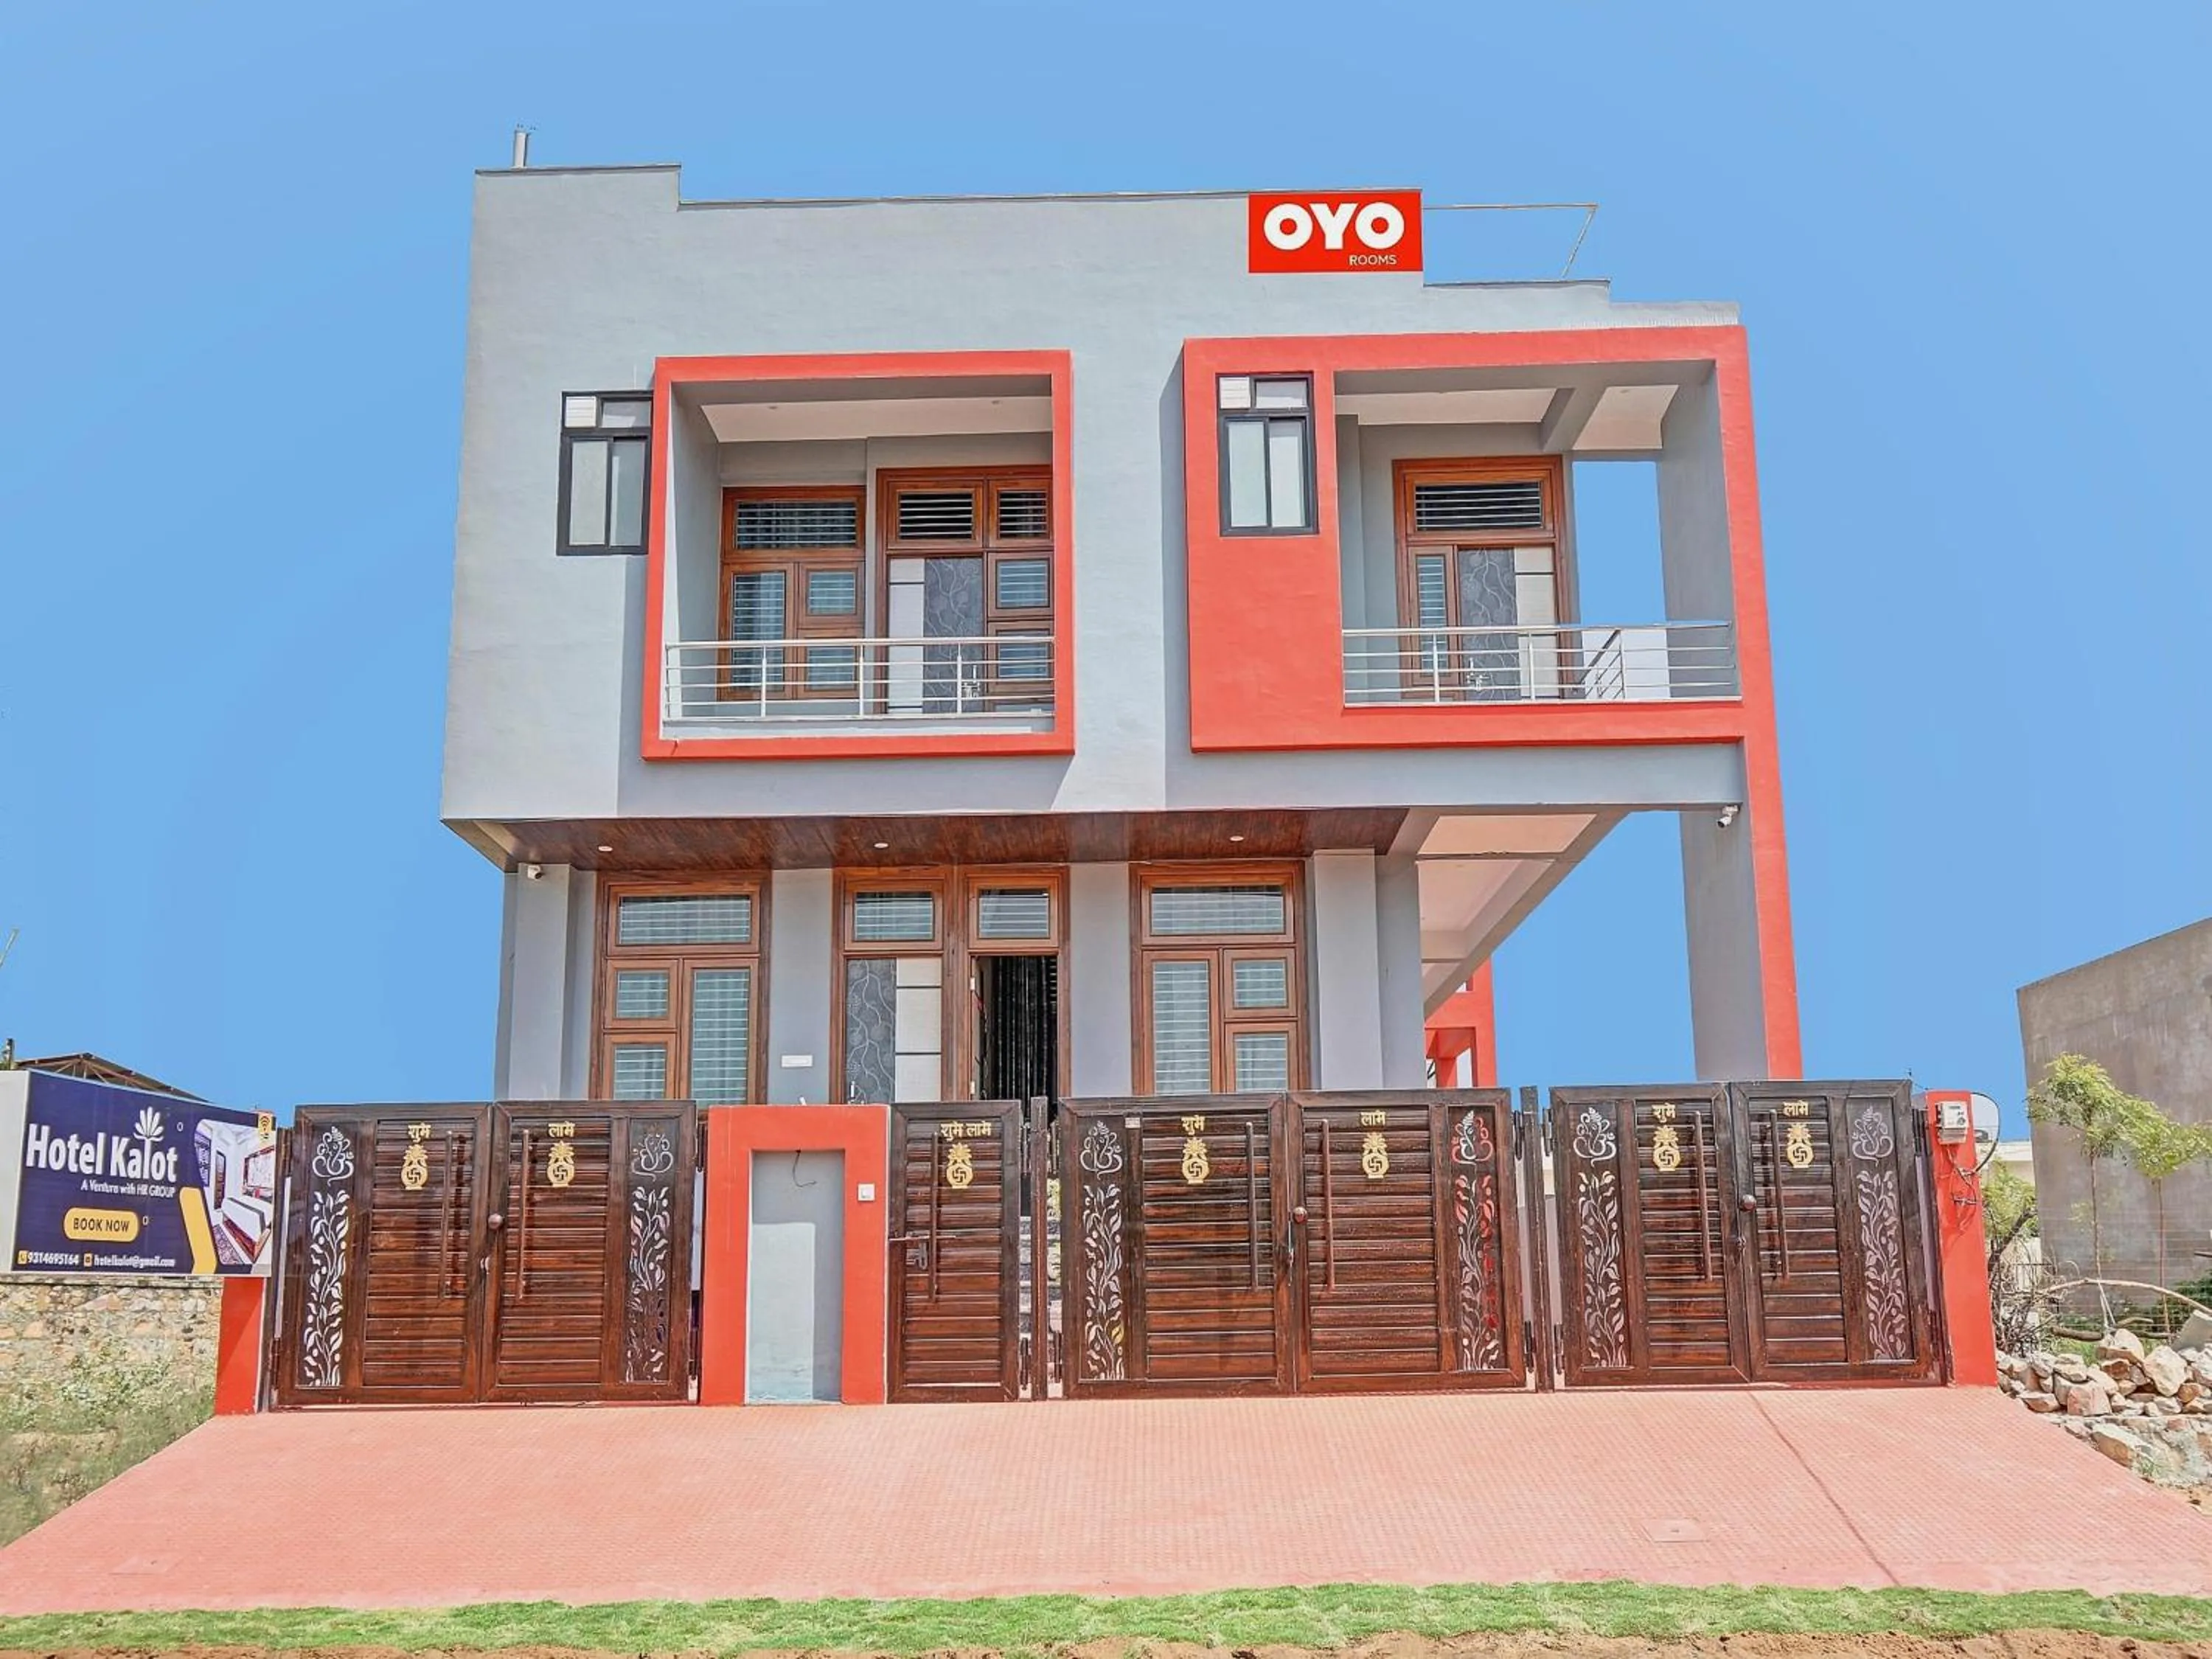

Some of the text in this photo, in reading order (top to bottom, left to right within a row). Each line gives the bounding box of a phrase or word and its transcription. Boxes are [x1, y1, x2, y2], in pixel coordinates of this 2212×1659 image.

[1264, 201, 1405, 251] OYO
[1349, 254, 1397, 265] ROOMS
[26, 1124, 178, 1183] Hotel Kalot
[80, 1180, 88, 1191] A
[149, 1185, 175, 1198] GROUP
[72, 1217, 130, 1232] BOOK NOW
